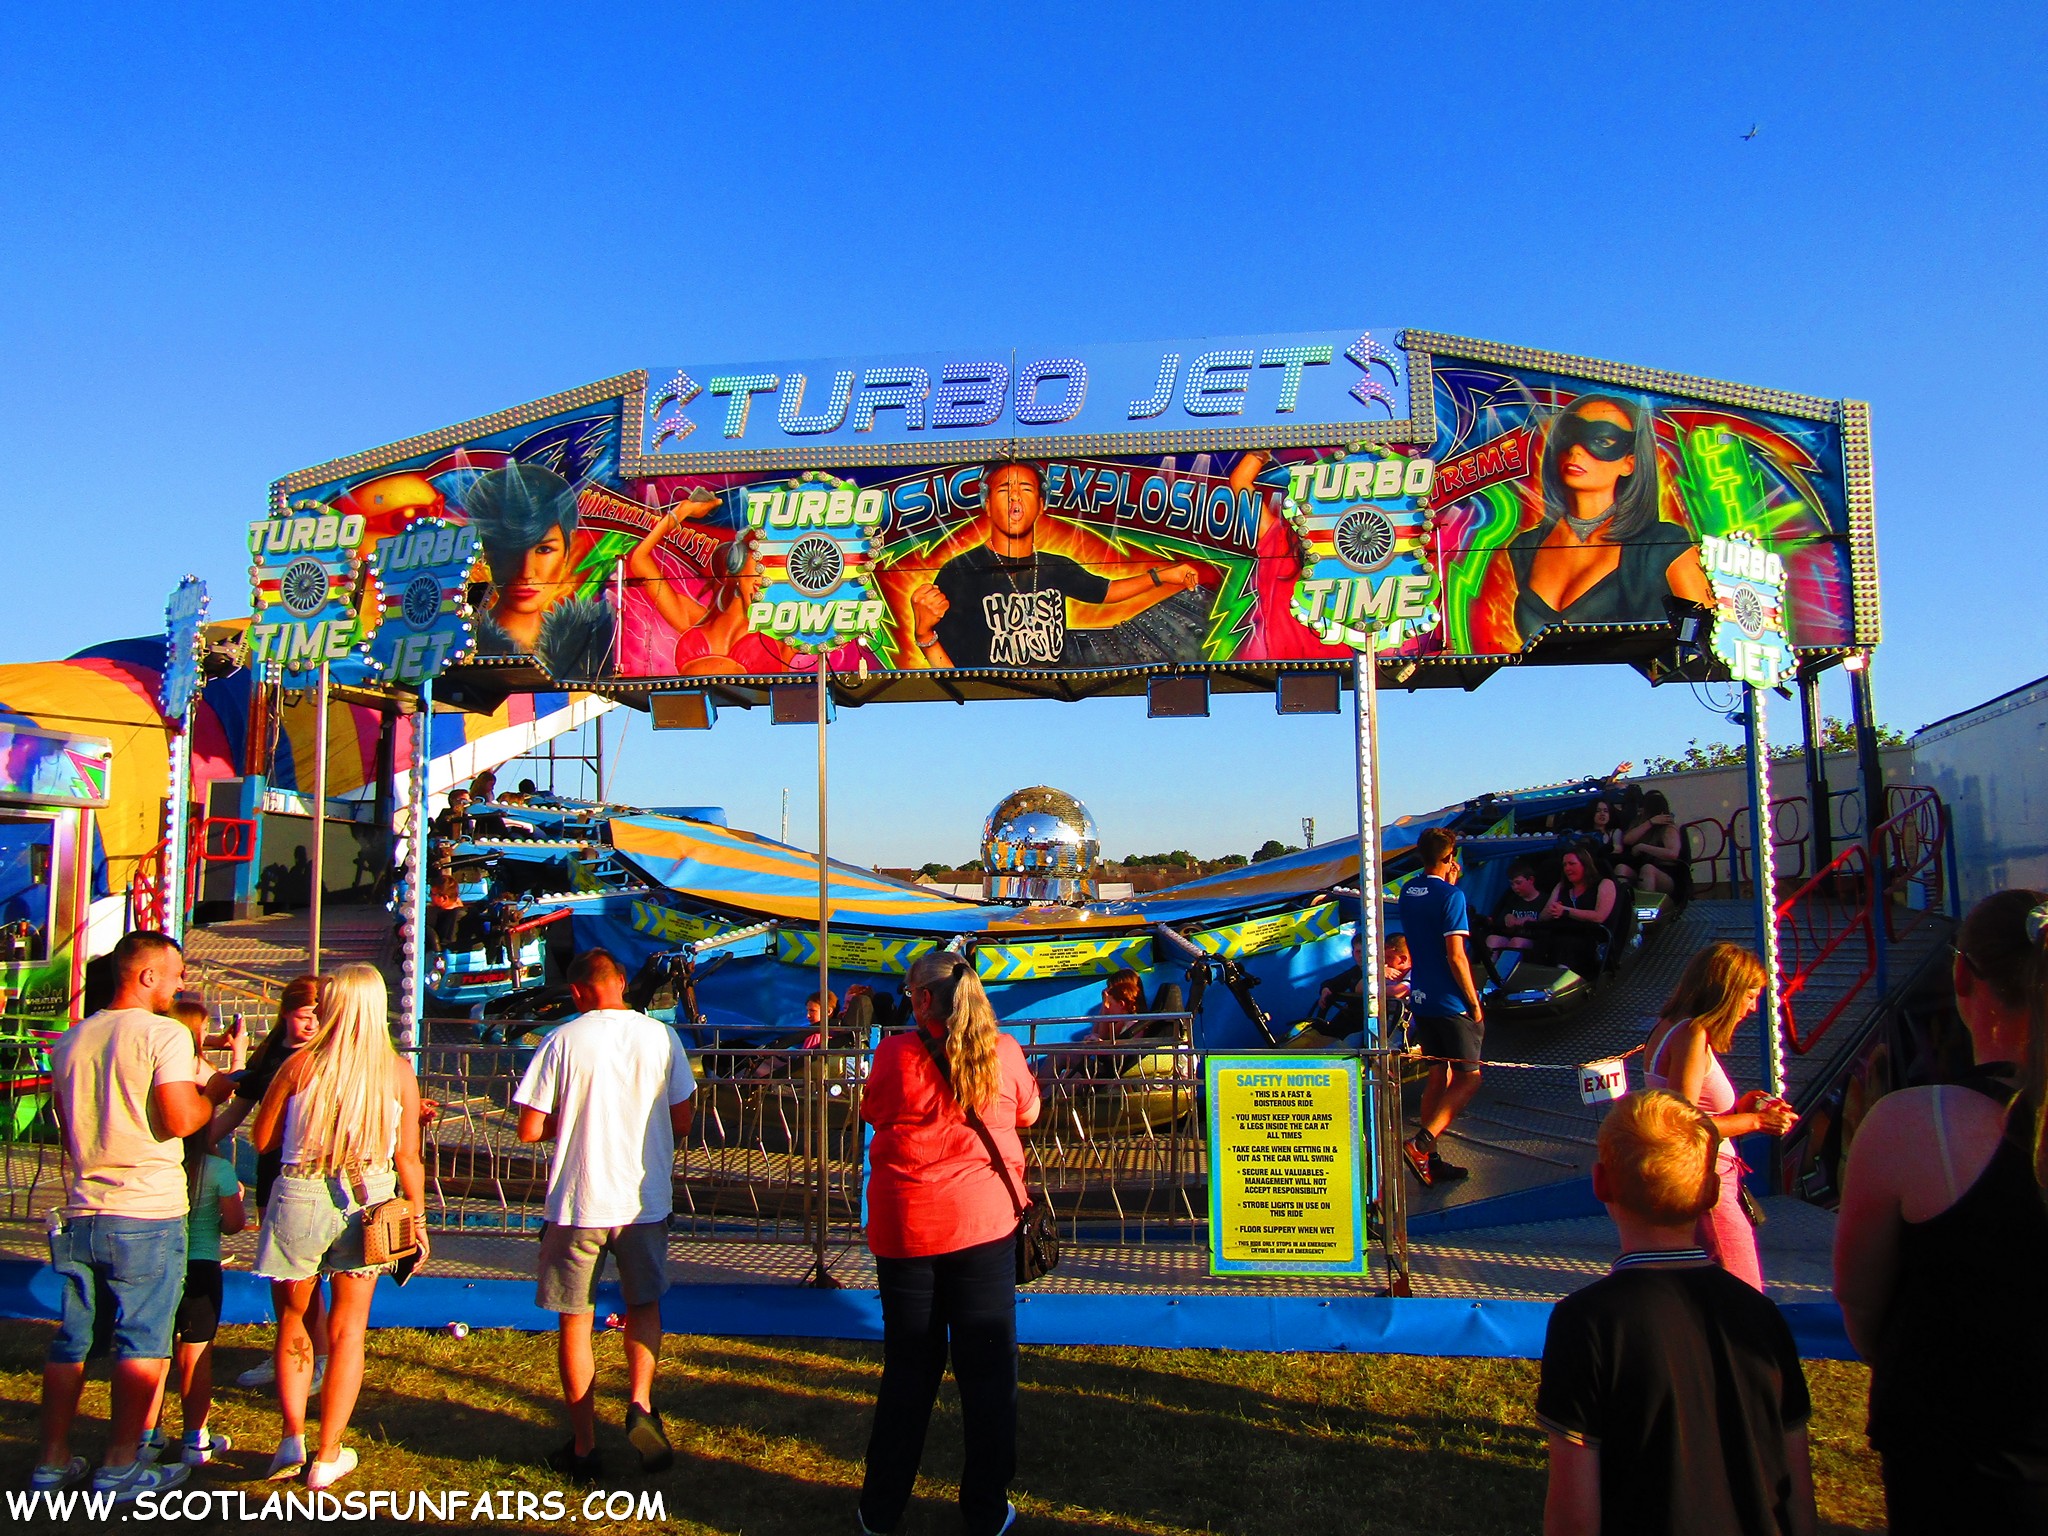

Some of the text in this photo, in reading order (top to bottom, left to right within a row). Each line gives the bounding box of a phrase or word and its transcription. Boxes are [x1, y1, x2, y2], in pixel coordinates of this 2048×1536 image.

[709, 345, 1333, 439] TURBO JET
[1290, 459, 1435, 501] TURBO
[1694, 426, 1758, 537] ULTI
[748, 490, 884, 527] TURBO
[1047, 463, 1262, 549] EXPLOSION
[249, 514, 366, 554] TURBO
[377, 525, 478, 571] TURBO
[664, 525, 720, 567] RUSH
[1703, 535, 1783, 584] TURBO
[748, 600, 884, 632] POWER
[982, 589, 1062, 633] HOUSE
[1303, 575, 1432, 622] TIME
[254, 619, 356, 663] TIME
[384, 633, 454, 681] JET
[1732, 640, 1781, 686] JET
[1237, 1075, 1330, 1086] SAFETY NOTICE
[1584, 1072, 1620, 1092] EXIT
